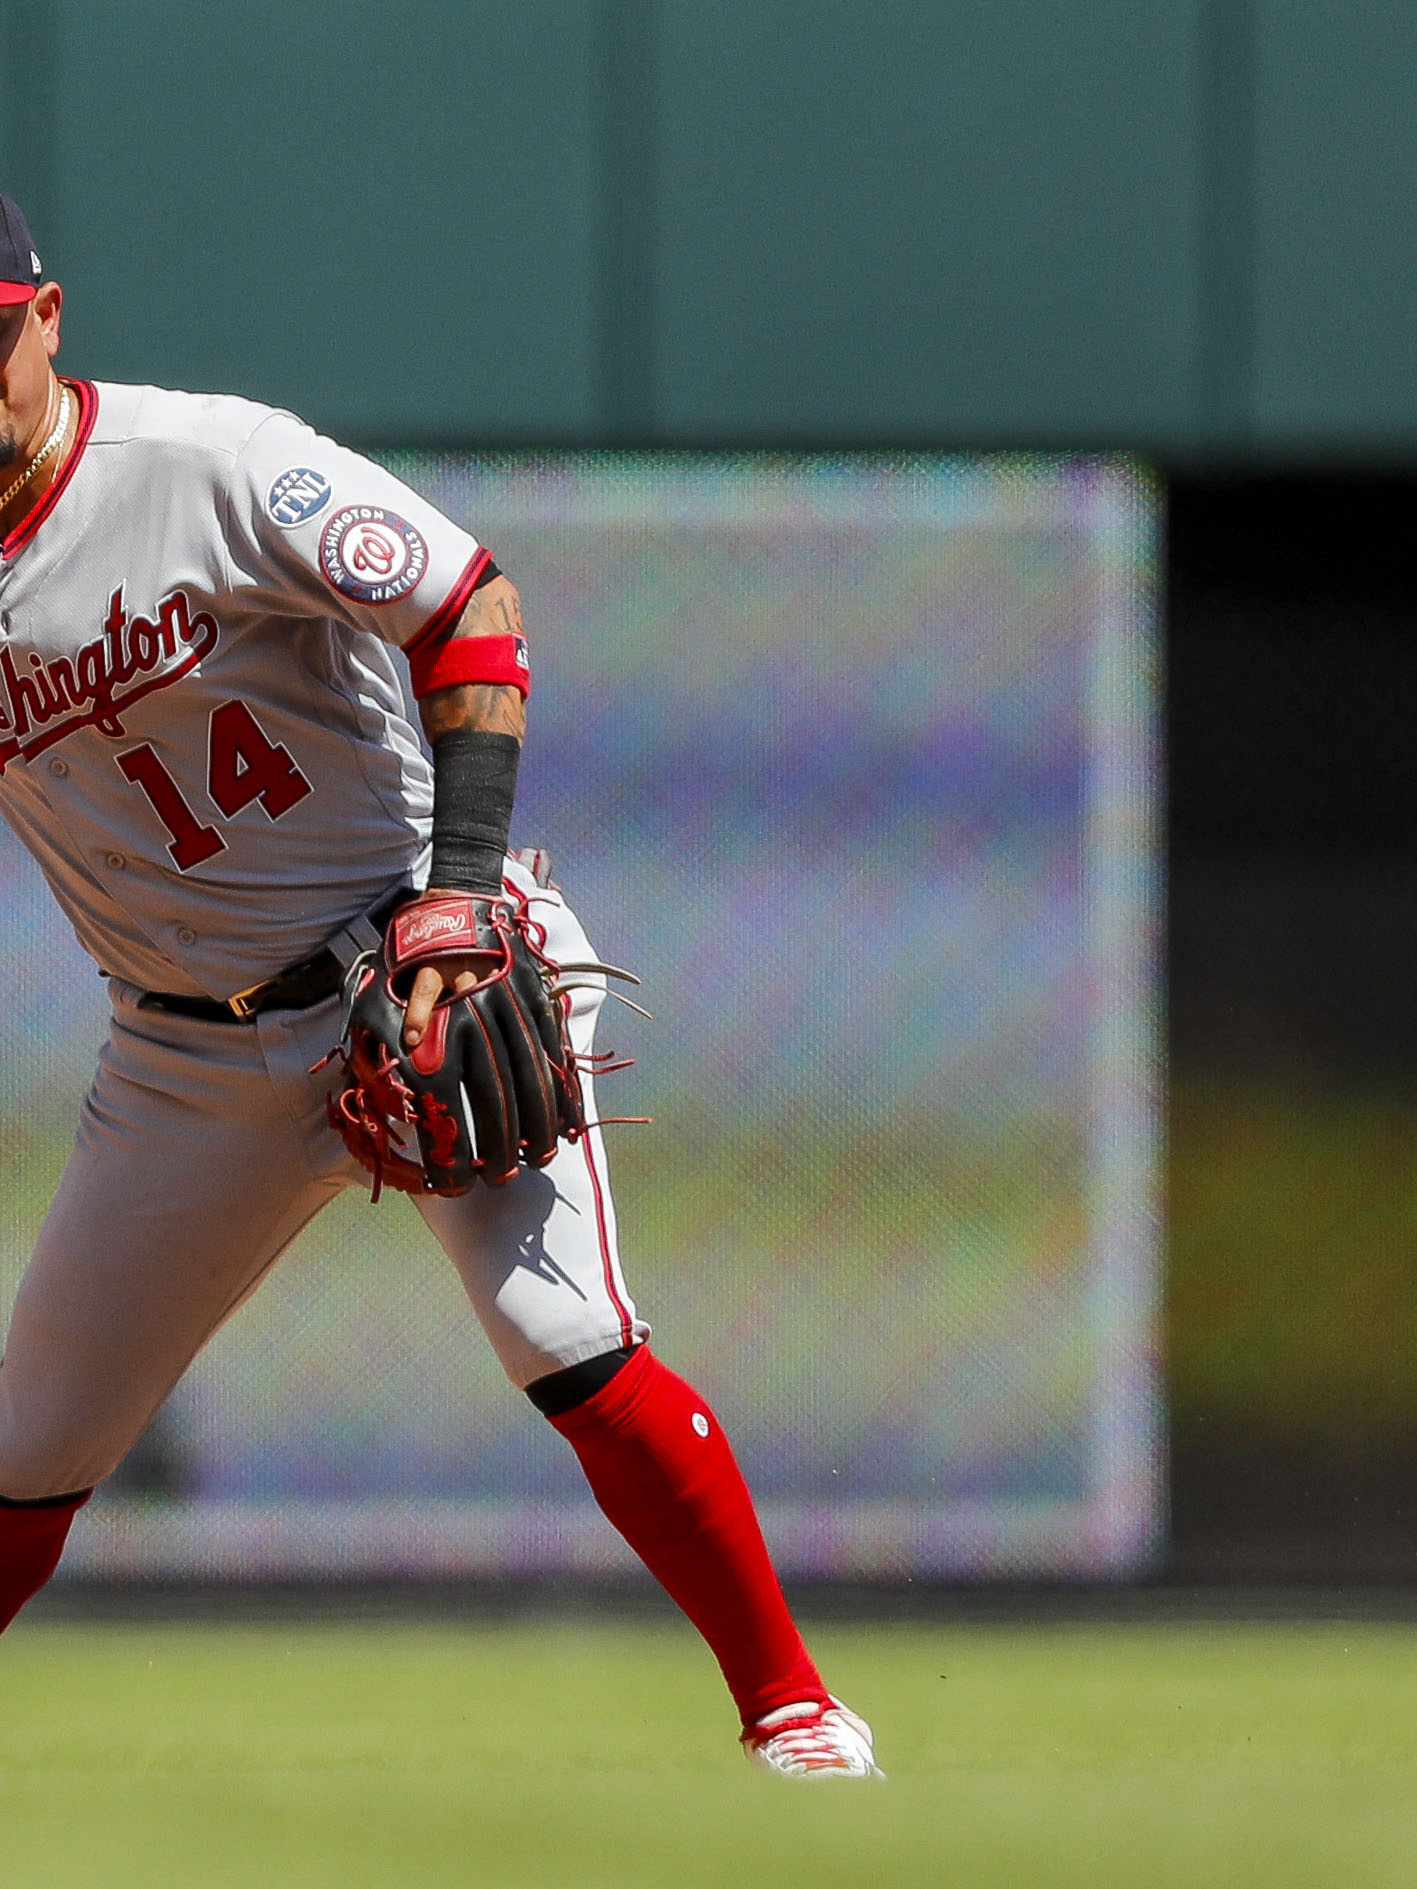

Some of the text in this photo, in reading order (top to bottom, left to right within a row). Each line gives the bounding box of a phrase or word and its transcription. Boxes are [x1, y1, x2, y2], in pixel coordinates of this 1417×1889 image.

[273, 470, 330, 523] TNL
[325, 508, 384, 583] WASHINGTON
[371, 531, 425, 601] NATIONALS
[115, 699, 314, 873] 14
